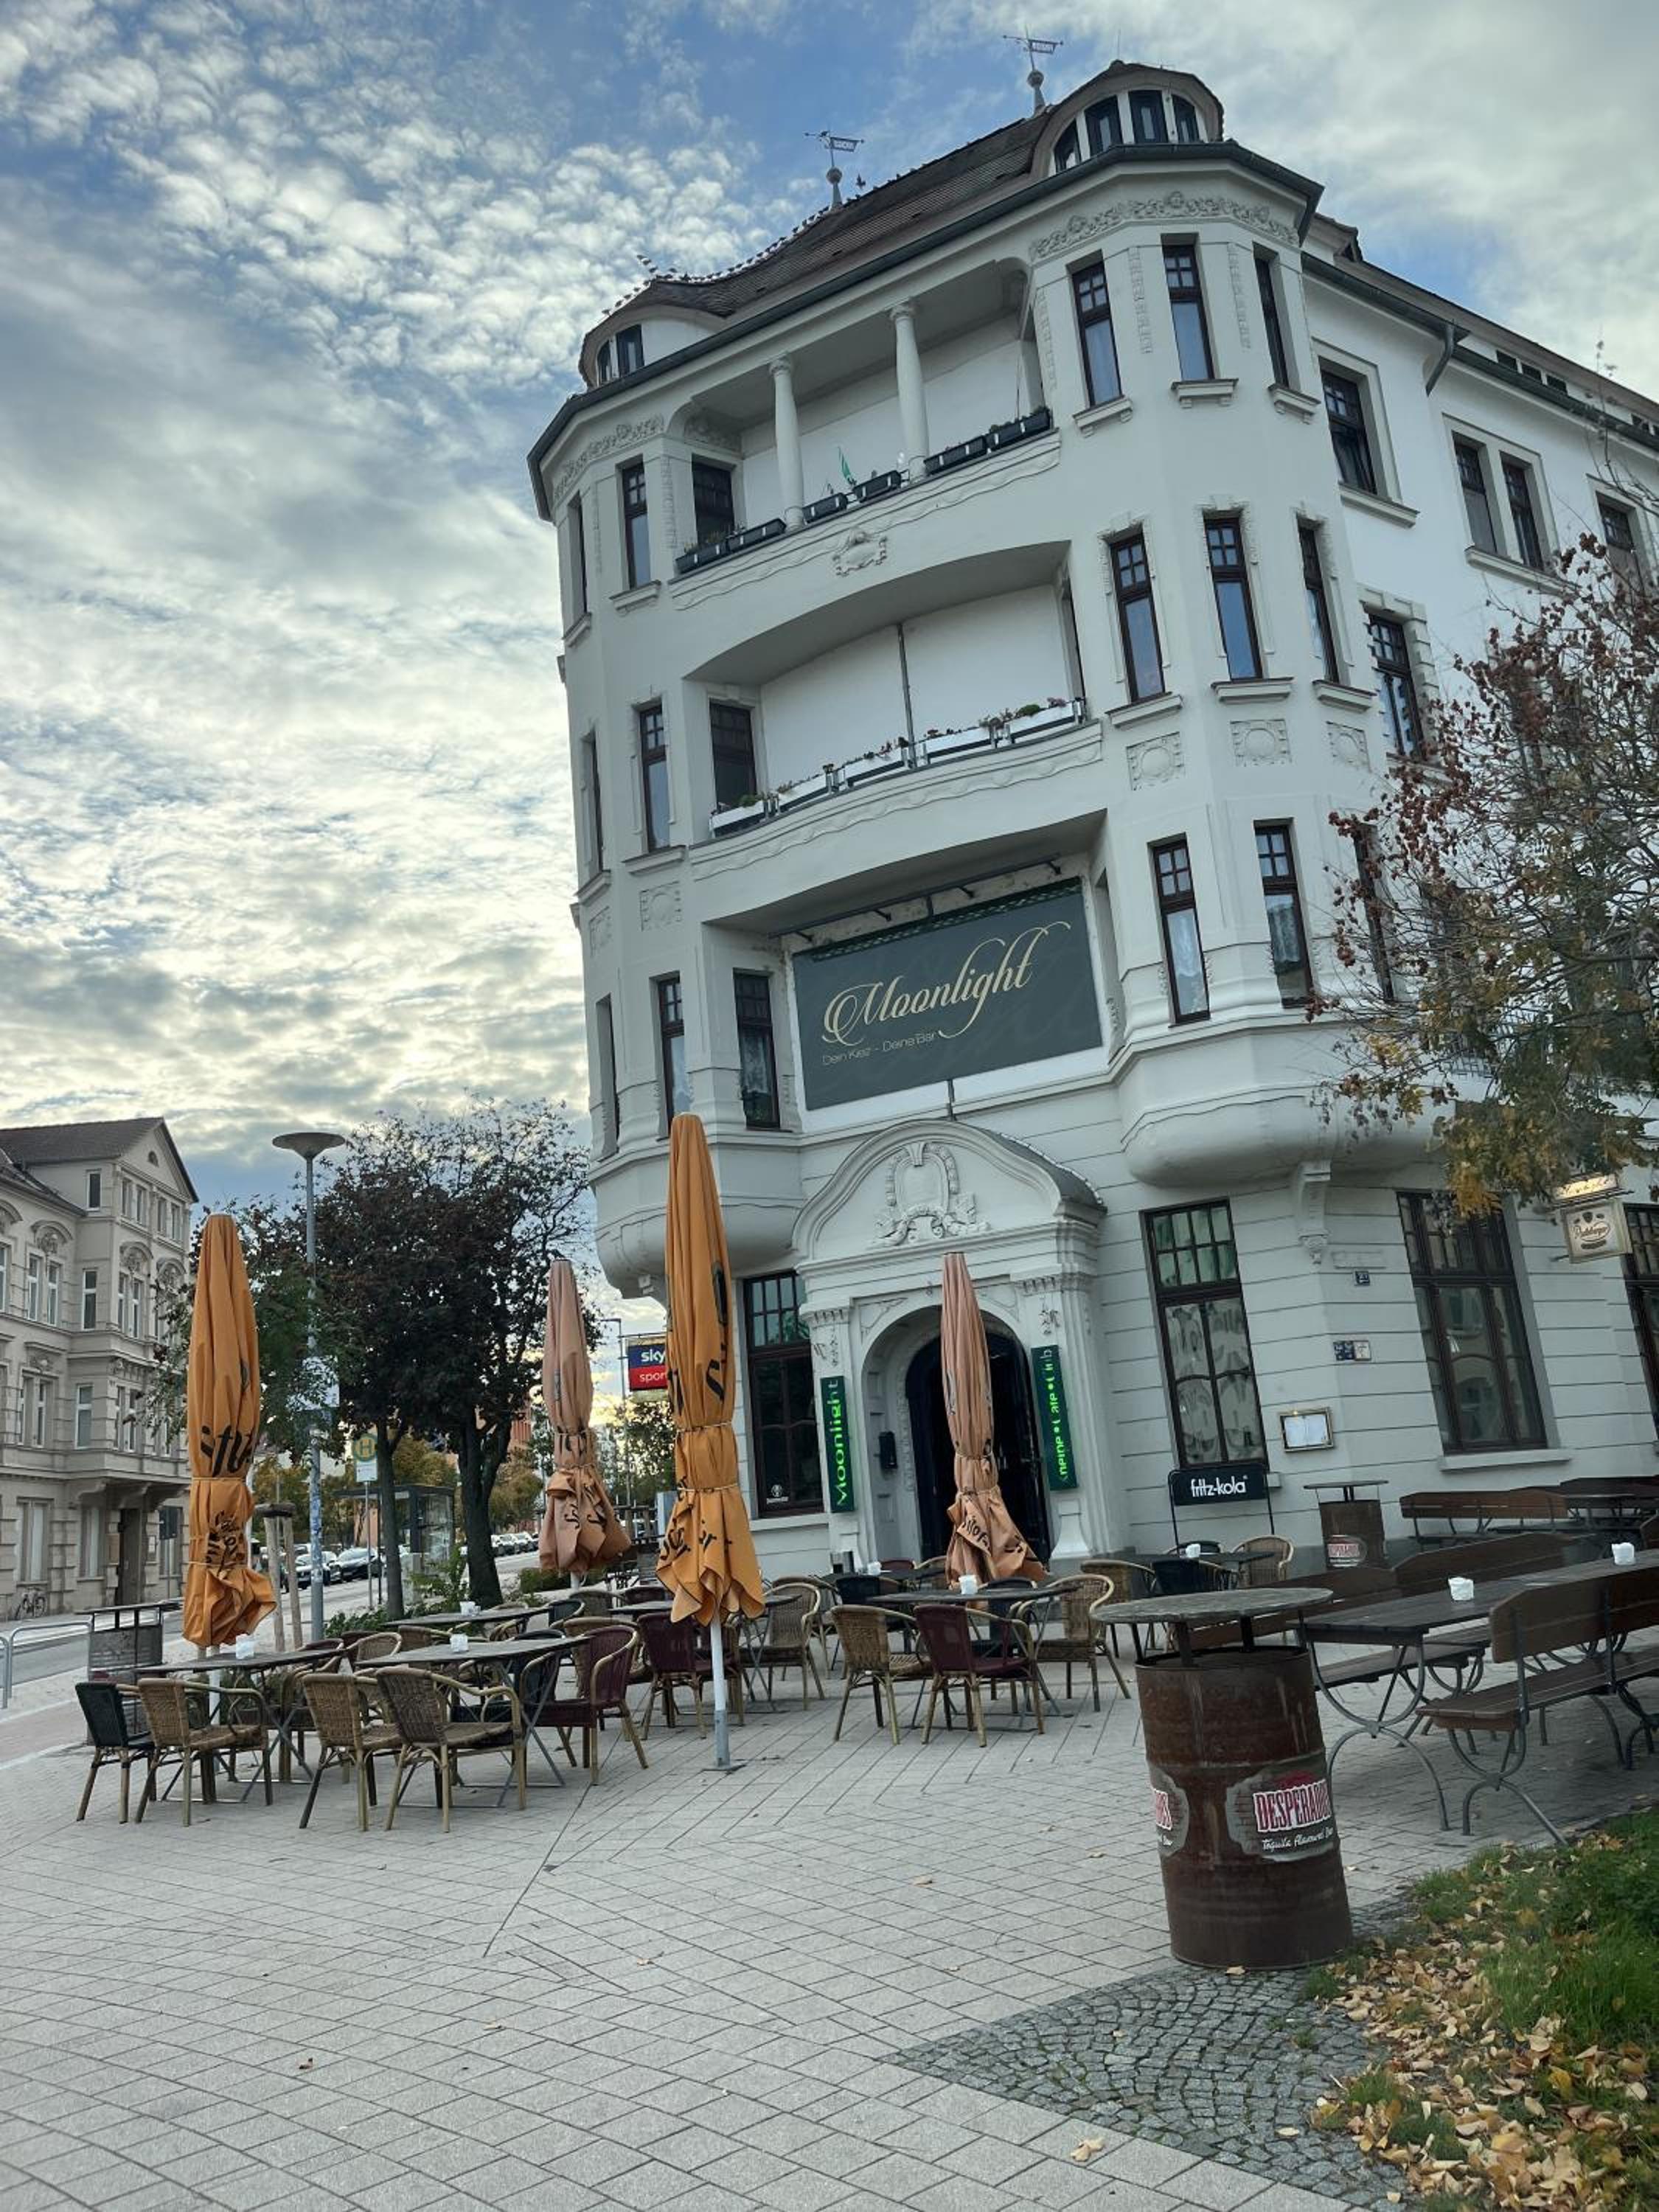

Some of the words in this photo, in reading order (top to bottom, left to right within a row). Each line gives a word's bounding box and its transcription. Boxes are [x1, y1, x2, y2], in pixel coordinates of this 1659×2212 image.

[822, 921, 1071, 1046] Moonlight
[641, 1349, 666, 1364] sky
[639, 1372, 667, 1383] spor
[827, 1380, 847, 1506] Moonlight
[1191, 1475, 1247, 1498] fritz-kola
[1262, 1837, 1291, 1852] Tequila
